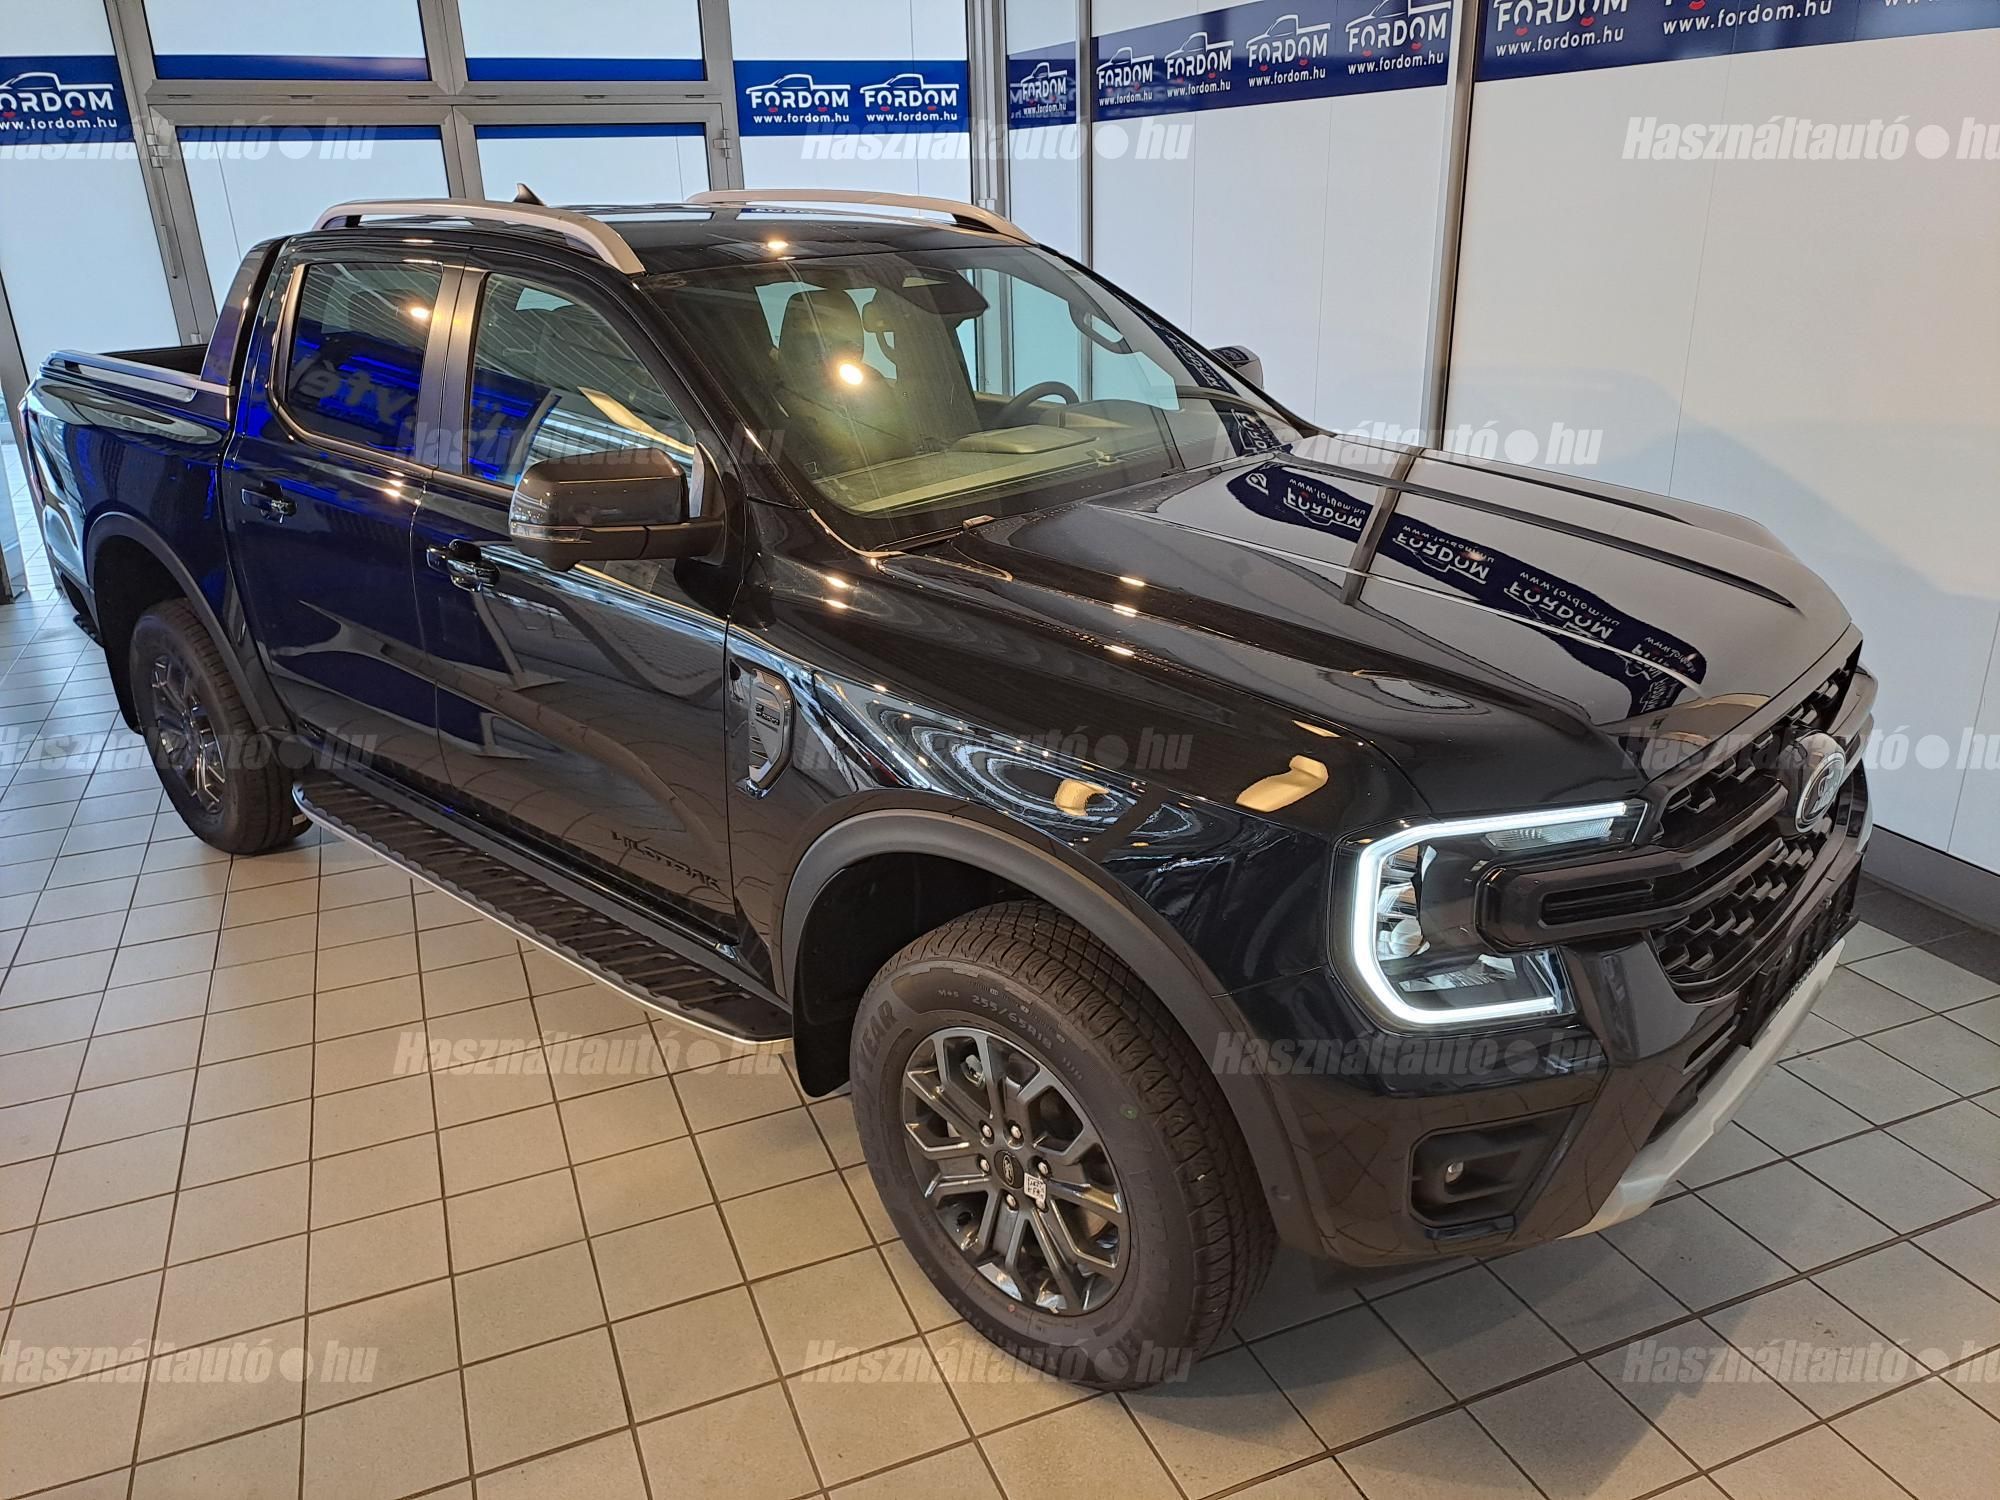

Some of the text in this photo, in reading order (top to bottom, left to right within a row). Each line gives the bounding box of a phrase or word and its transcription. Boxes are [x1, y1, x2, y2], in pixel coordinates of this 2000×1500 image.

[1663, 0, 1832, 35] www.fordom.hu
[1348, 13, 1448, 53] FORDOM
[1496, 26, 1624, 57] www.fordom.hu
[1248, 33, 1328, 68] FORDOM
[1166, 49, 1232, 80] FORDOM
[1348, 50, 1444, 75] www.fordom.hu
[1098, 63, 1153, 91] FORDOM
[1248, 67, 1326, 88] www.fordom.hu
[751, 90, 849, 109] FORDOM
[864, 89, 957, 108] FORDOM
[1022, 76, 1067, 101] FORDOM
[1099, 90, 1153, 107] www.fordom.hu
[1166, 79, 1231, 98] www.fordom.hu
[0, 91, 114, 113] ORDOM
[0, 117, 118, 131] ww.fordom.hu
[753, 113, 850, 124] www.fordom.hu
[866, 111, 958, 123] www.fordom.hu
